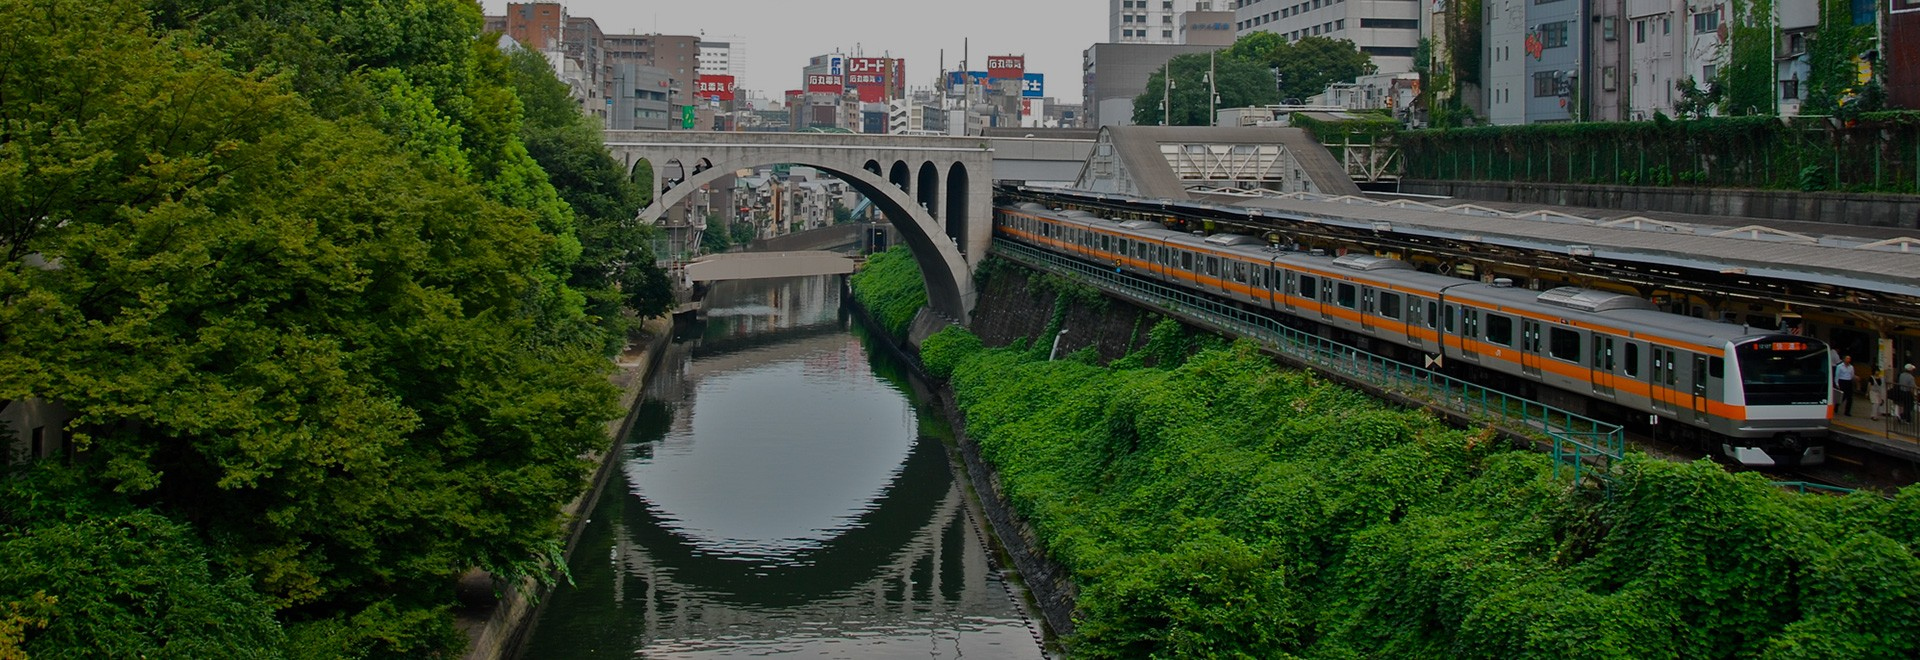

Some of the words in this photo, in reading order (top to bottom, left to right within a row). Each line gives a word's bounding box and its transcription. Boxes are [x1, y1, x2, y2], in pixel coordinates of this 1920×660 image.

[850, 59, 884, 72] レコード
[809, 76, 841, 85] 石丸電気
